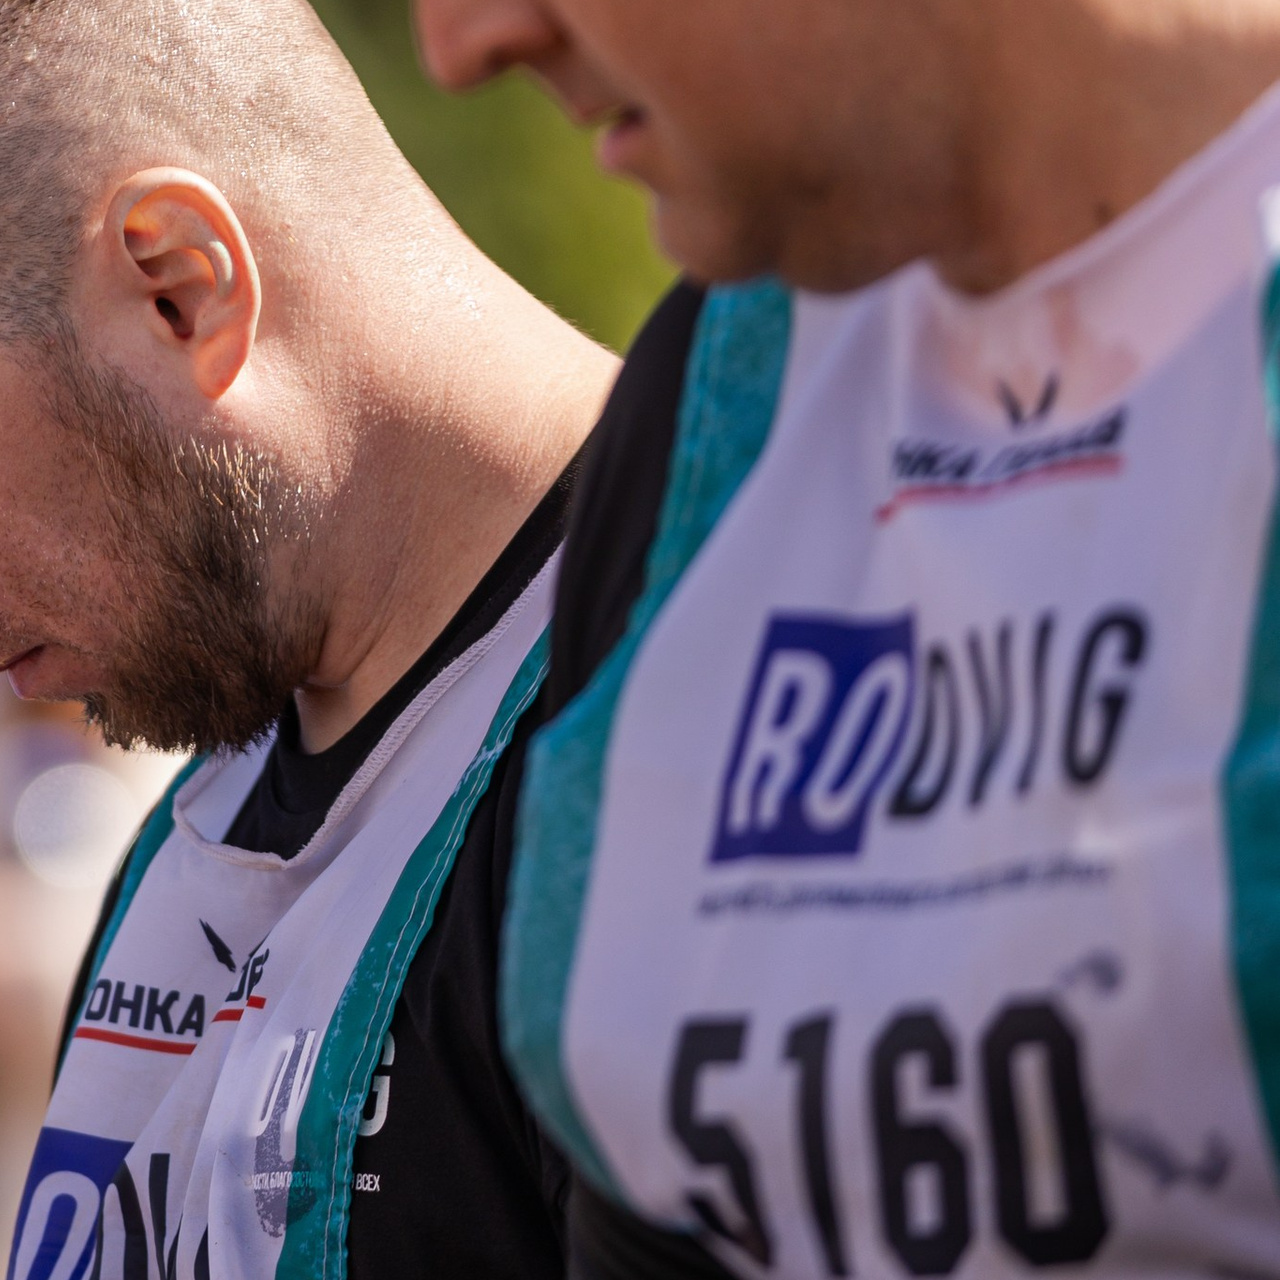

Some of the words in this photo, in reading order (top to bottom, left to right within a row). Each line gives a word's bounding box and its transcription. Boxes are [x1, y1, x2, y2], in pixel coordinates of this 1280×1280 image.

[726, 605, 1150, 836] RODVIG
[84, 978, 206, 1038] ОНКА
[355, 1172, 381, 1193] ВСЕХ
